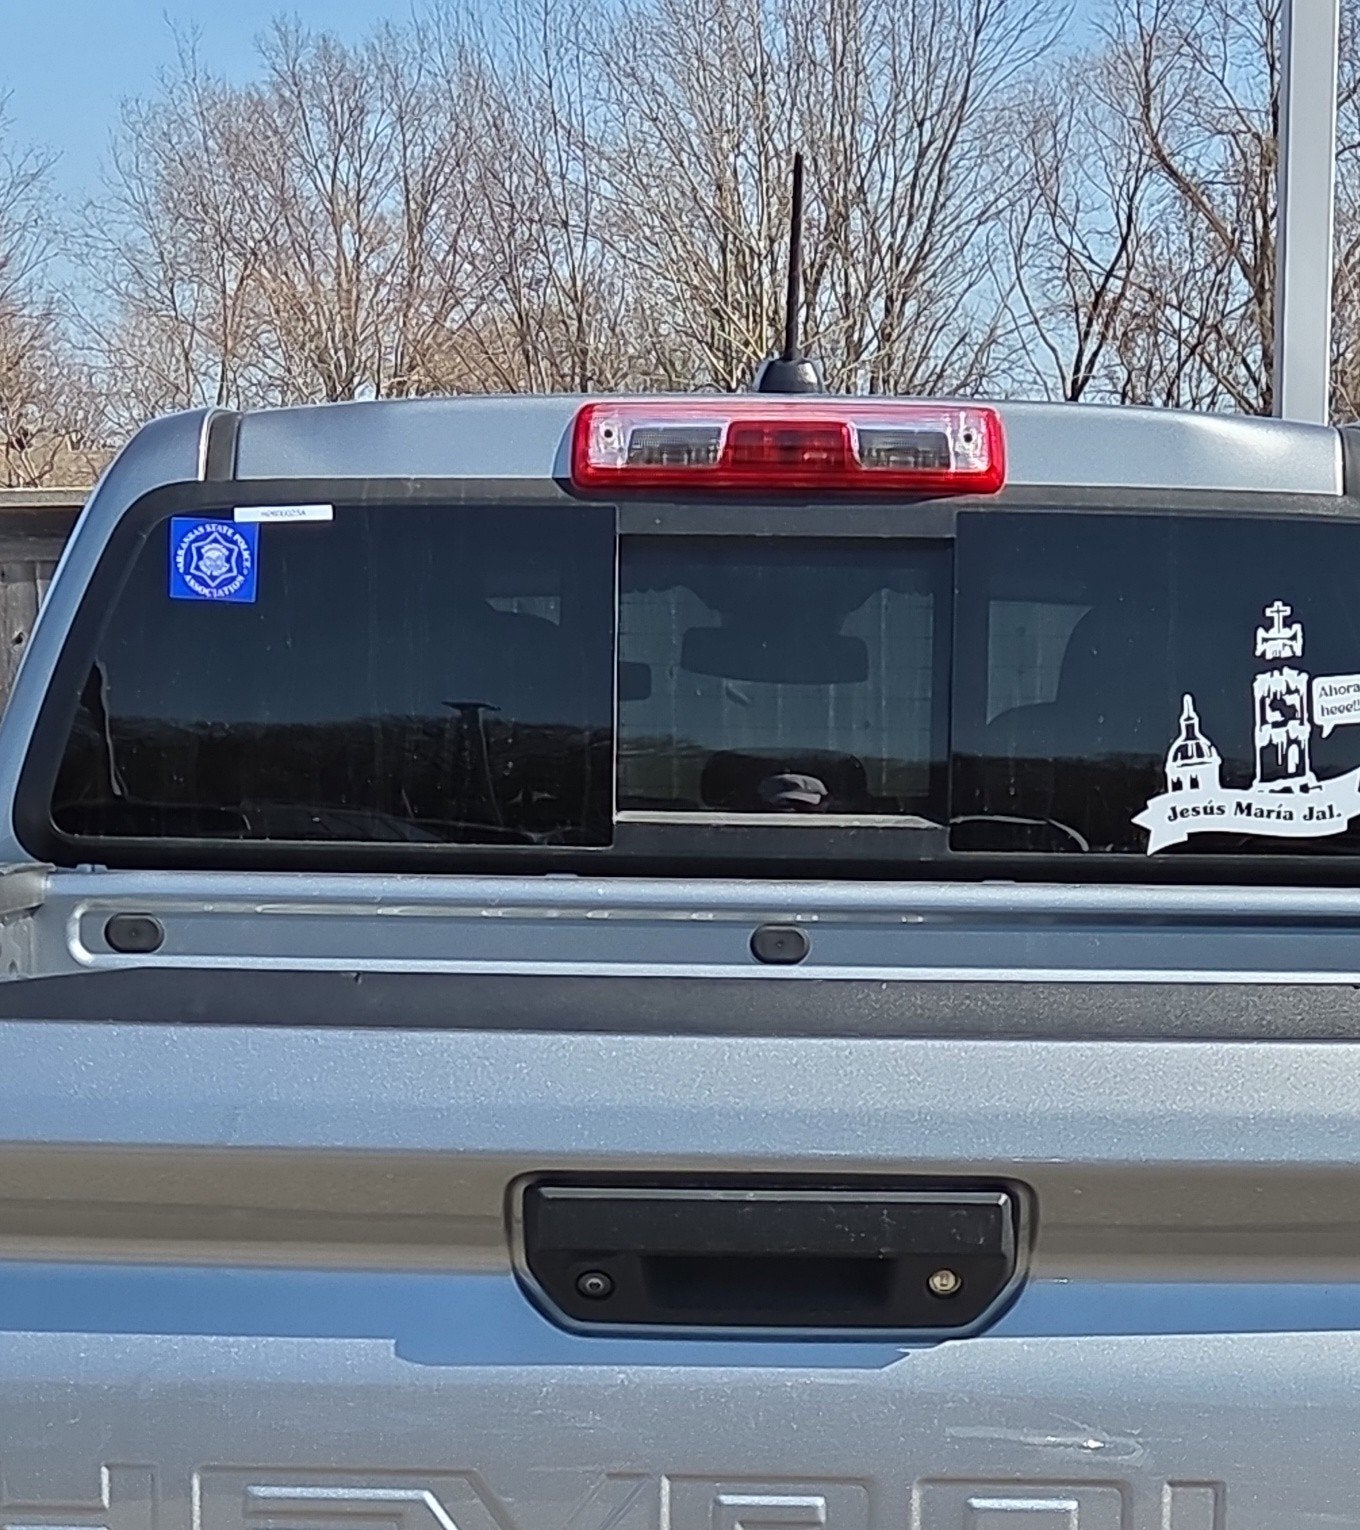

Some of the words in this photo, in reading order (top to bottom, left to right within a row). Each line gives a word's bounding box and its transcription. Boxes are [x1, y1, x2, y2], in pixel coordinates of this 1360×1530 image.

[176, 525, 205, 574] ARKANSAS
[204, 523, 235, 538] STATE
[232, 533, 251, 569] POLICE
[184, 574, 246, 598] ASSOCIATION
[1319, 684, 1360, 698] Ahora
[1167, 799, 1227, 822] Jesús
[1234, 801, 1294, 821] María
[1303, 804, 1342, 821] Jal.
